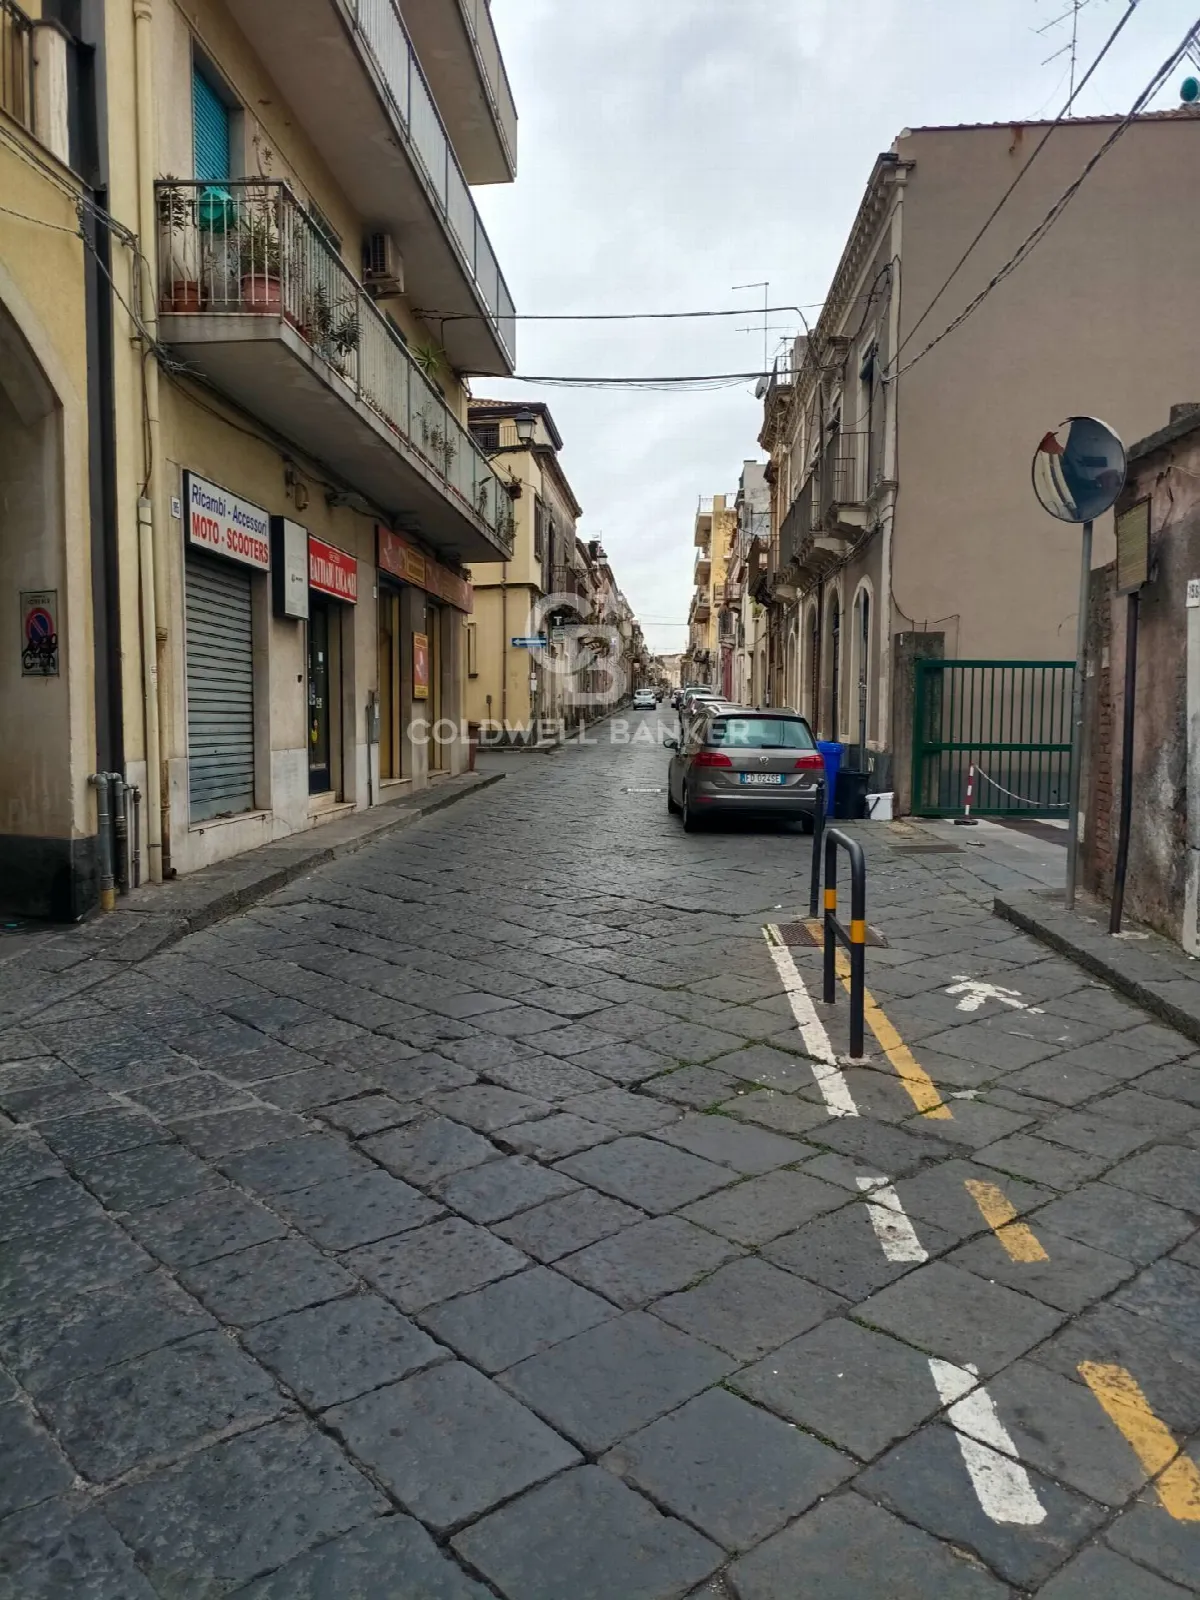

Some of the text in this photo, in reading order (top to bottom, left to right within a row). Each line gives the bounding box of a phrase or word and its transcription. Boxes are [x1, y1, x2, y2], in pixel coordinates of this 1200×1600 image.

[192, 484, 226, 518] Ricambi
[232, 505, 267, 537] Accessori
[192, 512, 220, 544] MOTO
[226, 527, 268, 563] SCOOTERS
